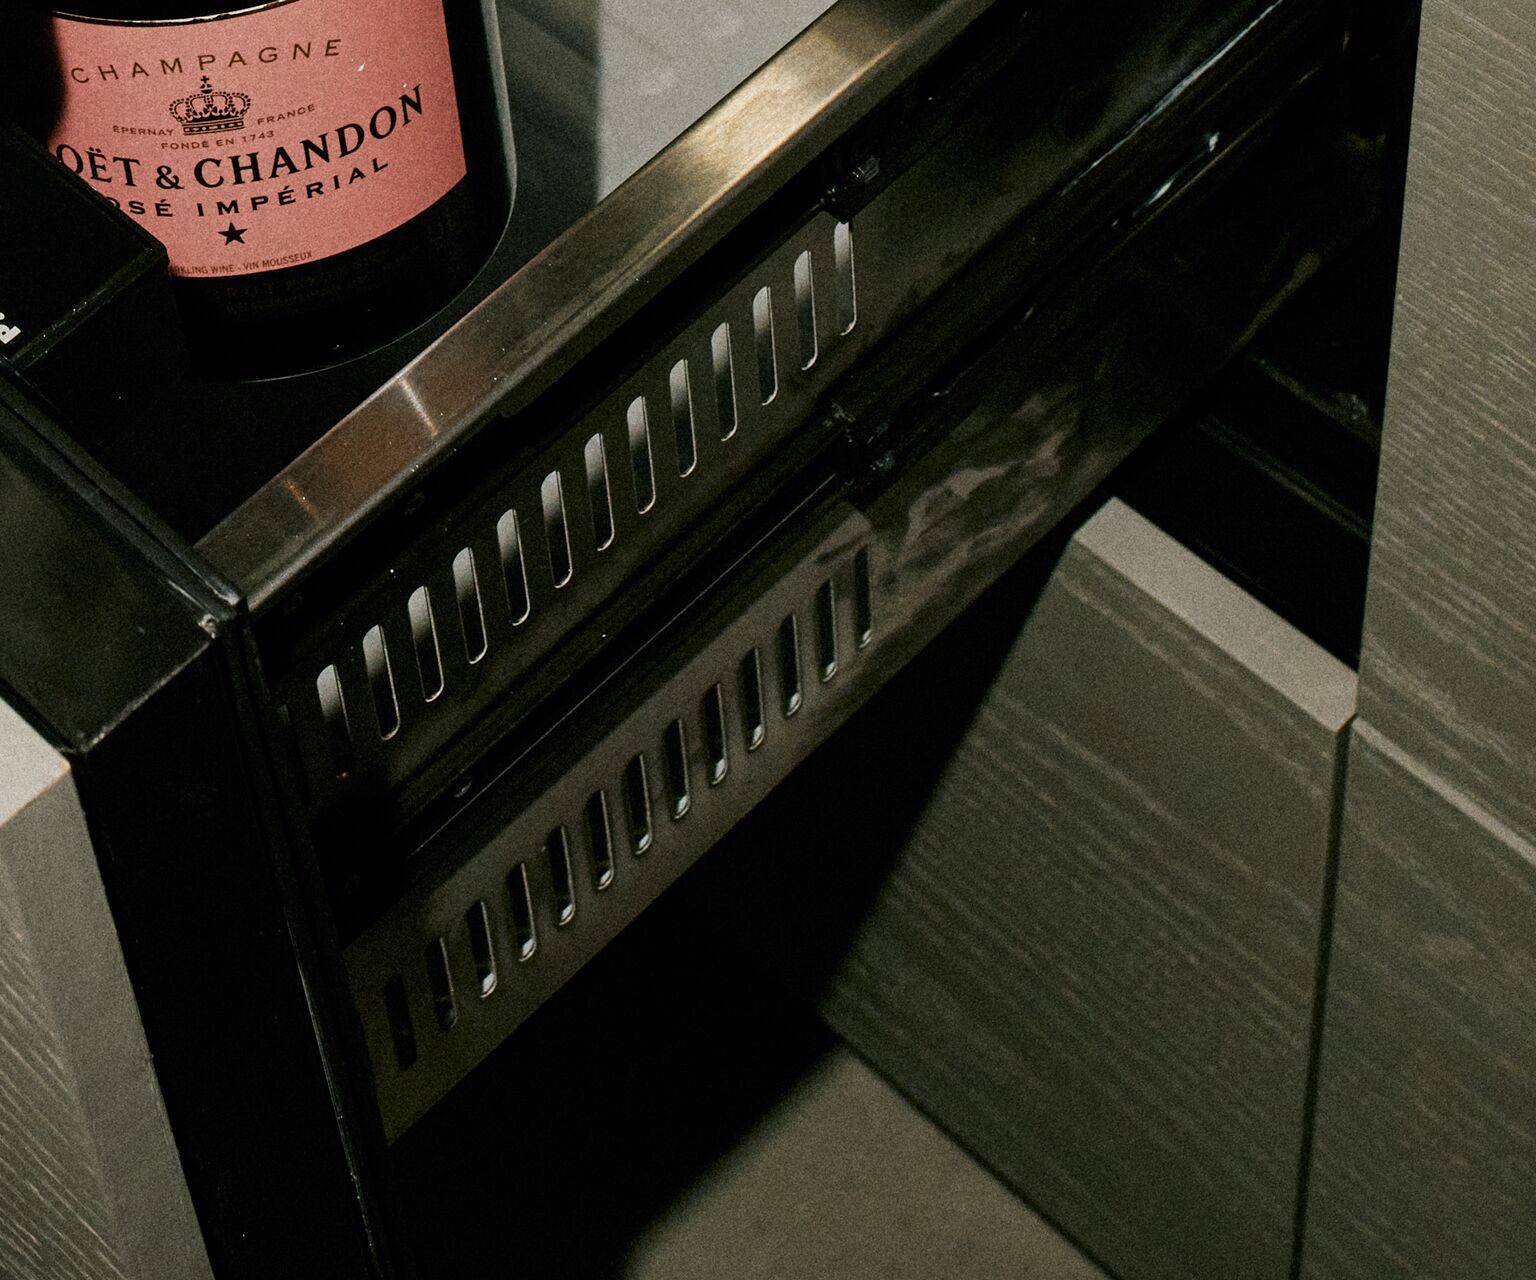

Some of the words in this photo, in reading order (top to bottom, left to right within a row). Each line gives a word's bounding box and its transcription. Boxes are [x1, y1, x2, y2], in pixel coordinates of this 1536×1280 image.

[70, 37, 343, 85] CHAMPAGNE
[256, 103, 316, 126] FRANCE
[55, 143, 141, 188] OËT
[155, 164, 185, 191] &
[193, 83, 424, 189] CHANDON
[215, 137, 235, 148] EN
[242, 130, 275, 143] 1743
[196, 157, 389, 217] IMPÉRIAL
[208, 263, 235, 274] WINE
[242, 261, 260, 271] VIN
[261, 250, 313, 269] MOUSSEUX
